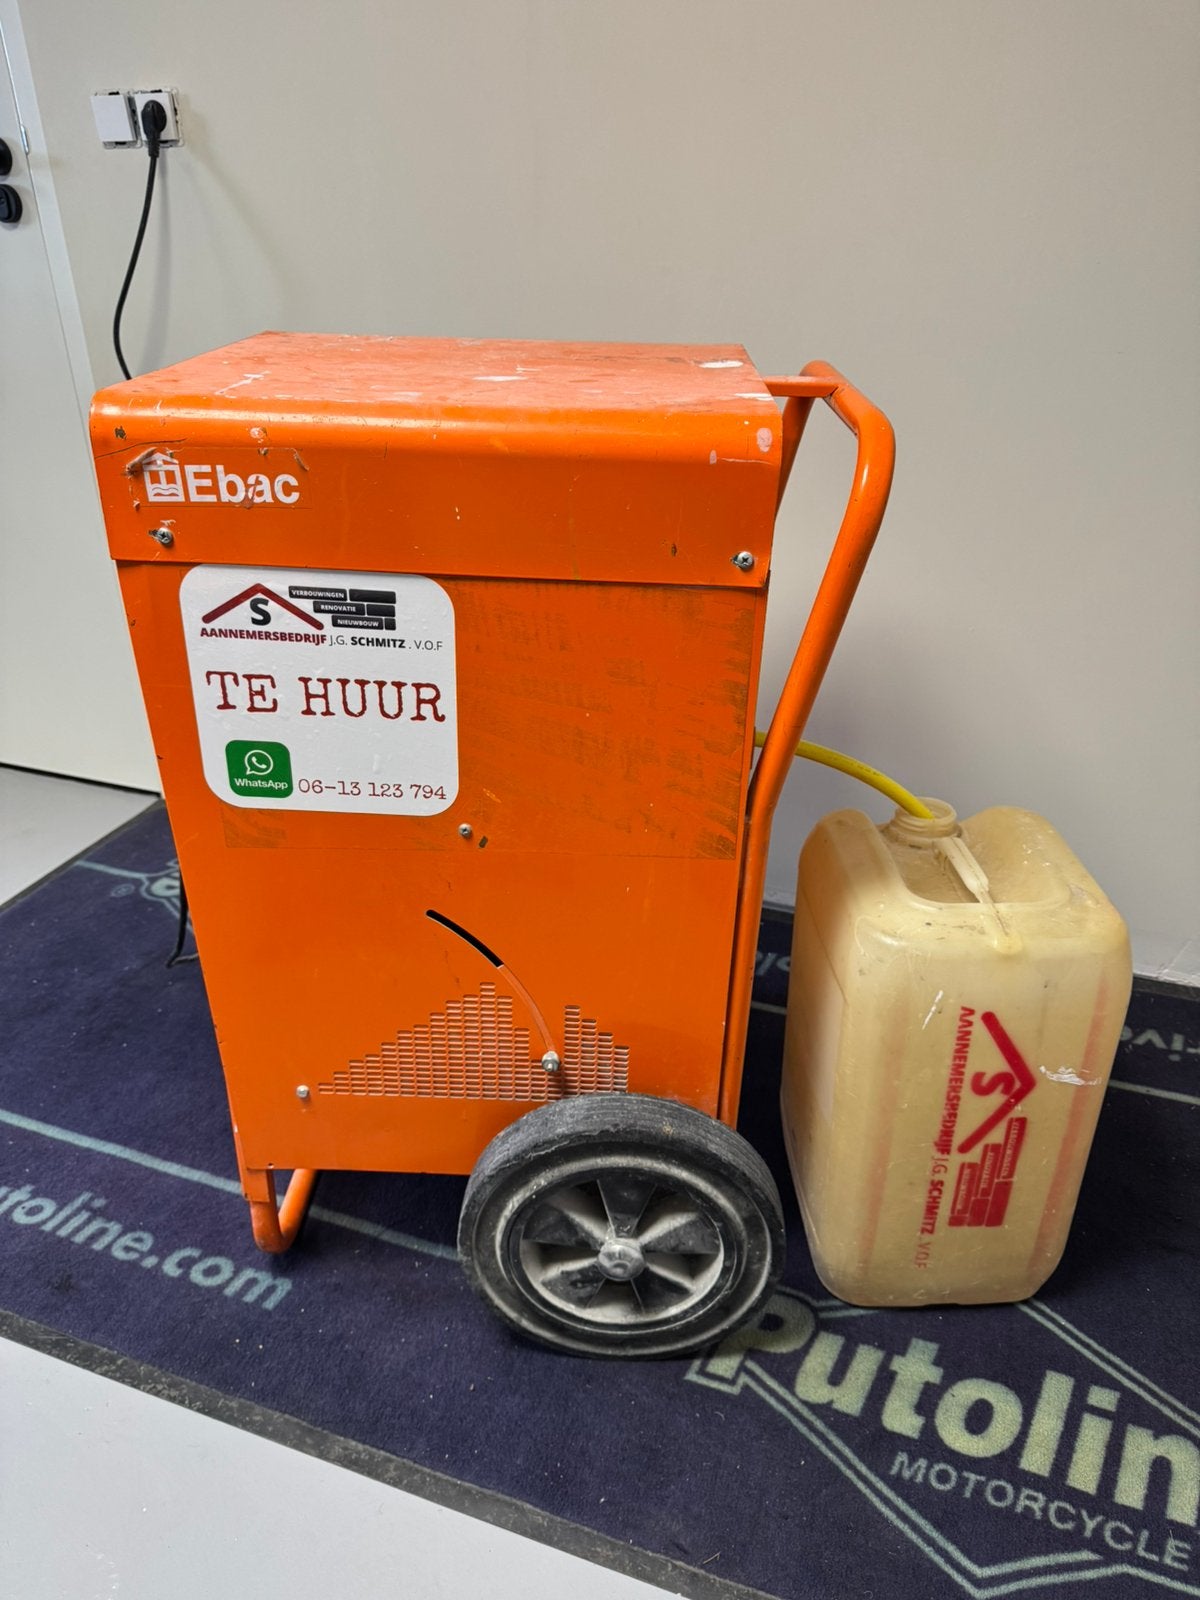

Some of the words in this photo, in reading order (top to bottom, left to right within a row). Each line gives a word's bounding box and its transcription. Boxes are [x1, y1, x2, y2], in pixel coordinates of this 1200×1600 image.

[184, 464, 300, 503] Ebac
[291, 589, 345, 599] VERBOUWINGEN
[250, 598, 271, 626] S
[320, 604, 356, 612] RENOVATIE
[337, 619, 379, 627] NIEUWBOUW
[200, 628, 327, 646] AANNEMERSBEDRIJF
[329, 634, 348, 646] J.G.
[350, 636, 406, 649] SCHMITZ
[205, 670, 278, 713] TE
[297, 676, 446, 722] HUUR
[234, 778, 289, 790] WhatsApp
[298, 778, 361, 796] 06-13
[368, 782, 403, 798] 123
[410, 784, 446, 800] 794
[970, 1071, 1016, 1097] S
[920, 1179, 945, 1235] SCHMITZ
[0, 1185, 293, 1310] toline.com
[706, 1294, 1200, 1531] Putolin
[889, 1452, 1193, 1571] MOTORCYCLE
